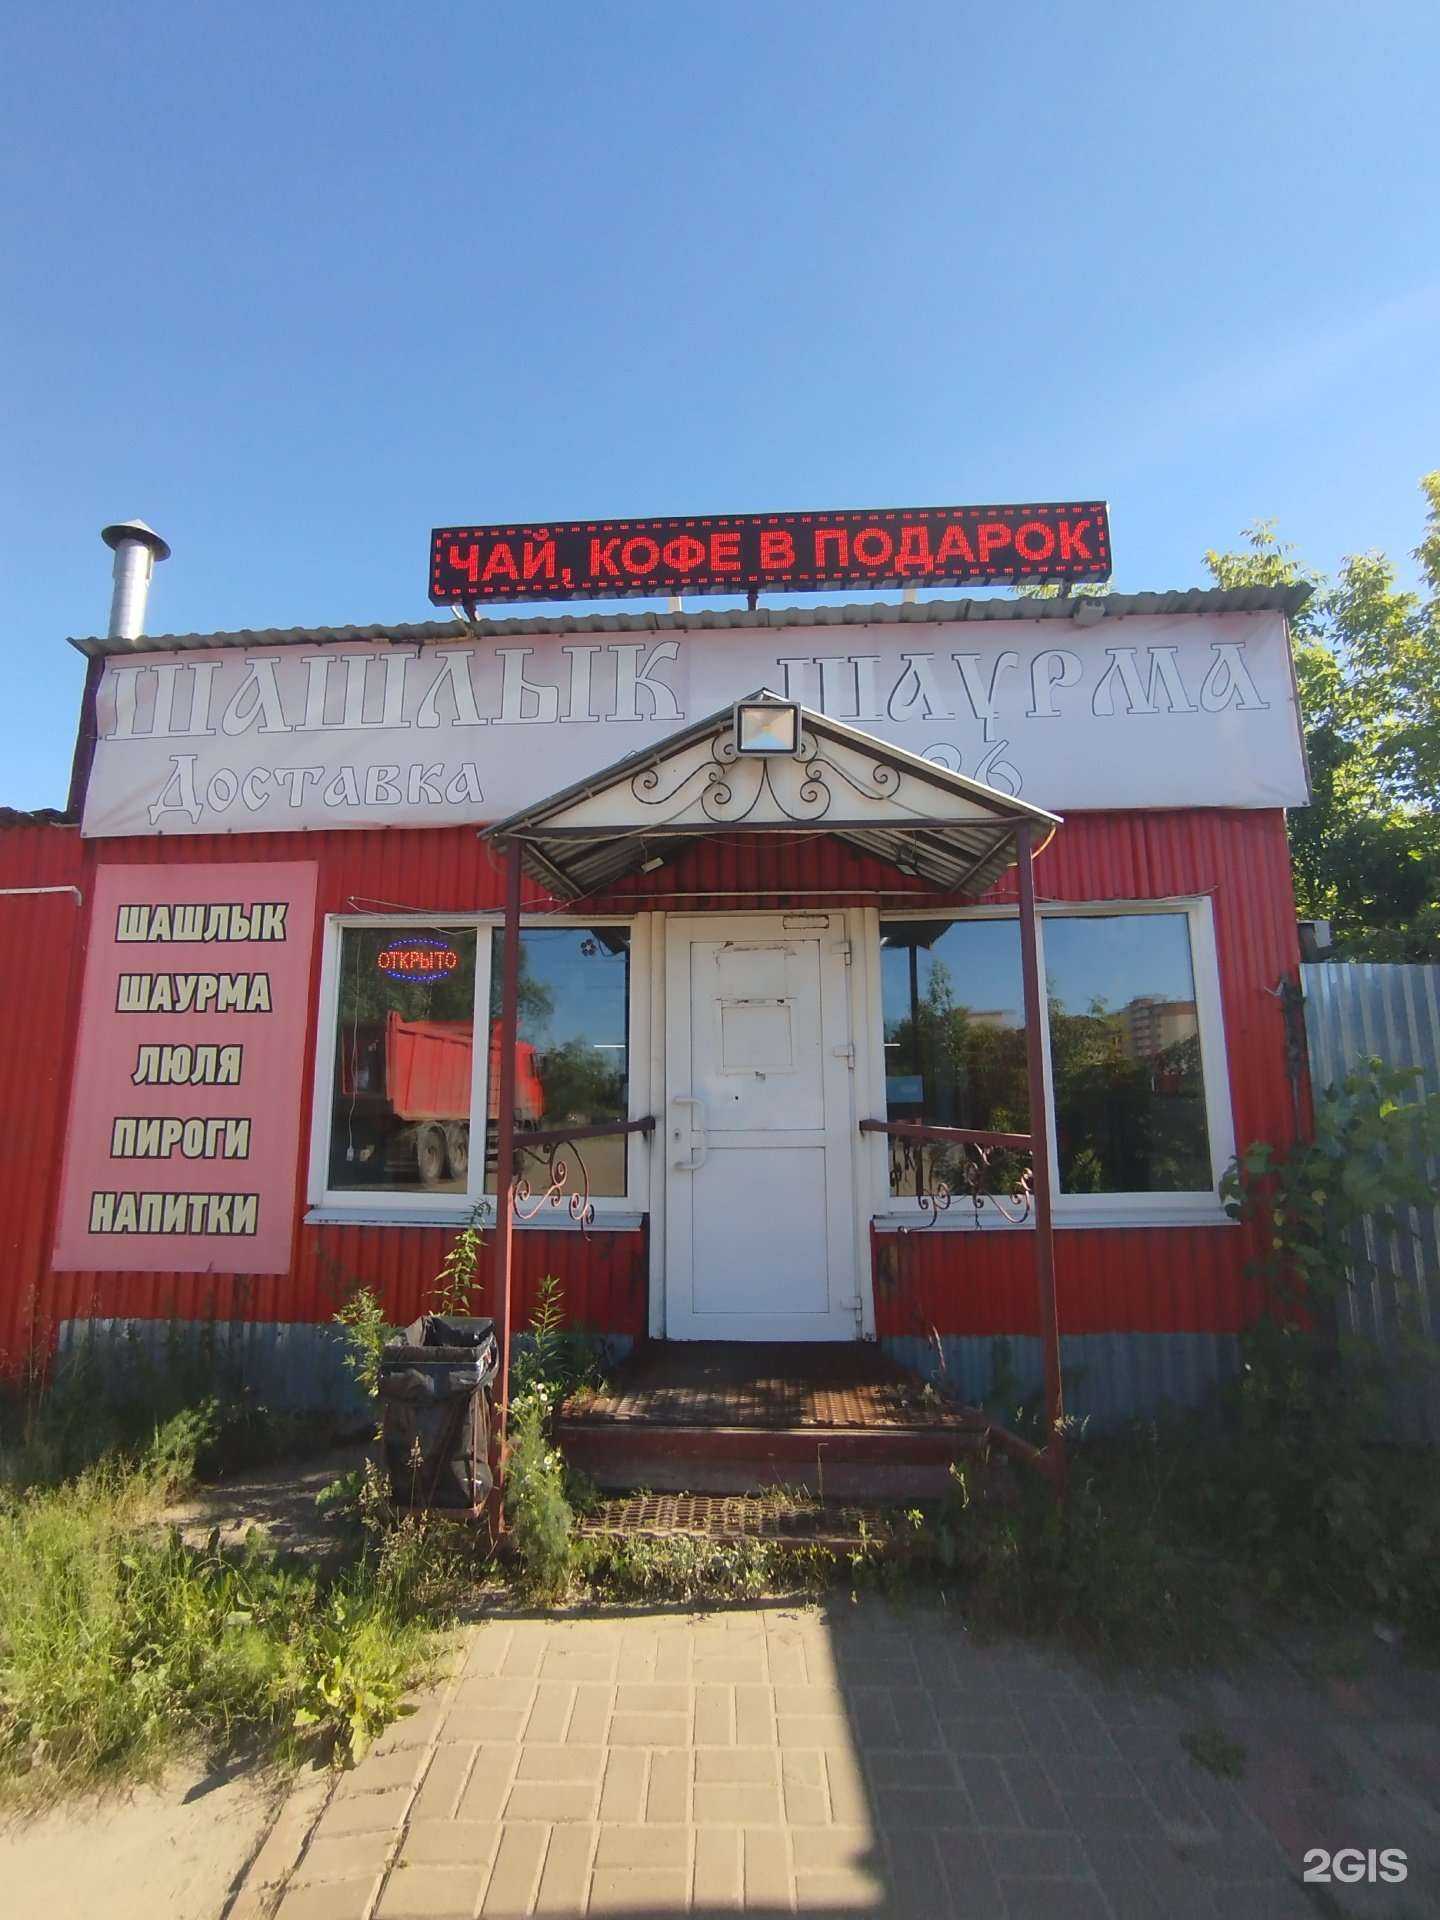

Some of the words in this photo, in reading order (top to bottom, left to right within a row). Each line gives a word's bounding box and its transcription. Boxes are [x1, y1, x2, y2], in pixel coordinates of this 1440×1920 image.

[449, 528, 572, 588] ЧАЙ,
[590, 532, 742, 576] КОФЕ
[760, 530, 796, 569] В
[814, 519, 1093, 577] ПОДАРОК
[104, 640, 685, 742] ШАШЛЫК
[776, 642, 1270, 742] ШАУРМА
[147, 754, 485, 825] Доставка
[115, 902, 288, 943] ШАШЛЫК
[377, 950, 458, 971] ОТКРЫТО
[115, 973, 272, 1013] ШАУРМА
[131, 1044, 243, 1086] ЛЮЛЯ
[109, 1117, 251, 1159] ПИРОГИ
[88, 1191, 260, 1236] НАПИТКИ
